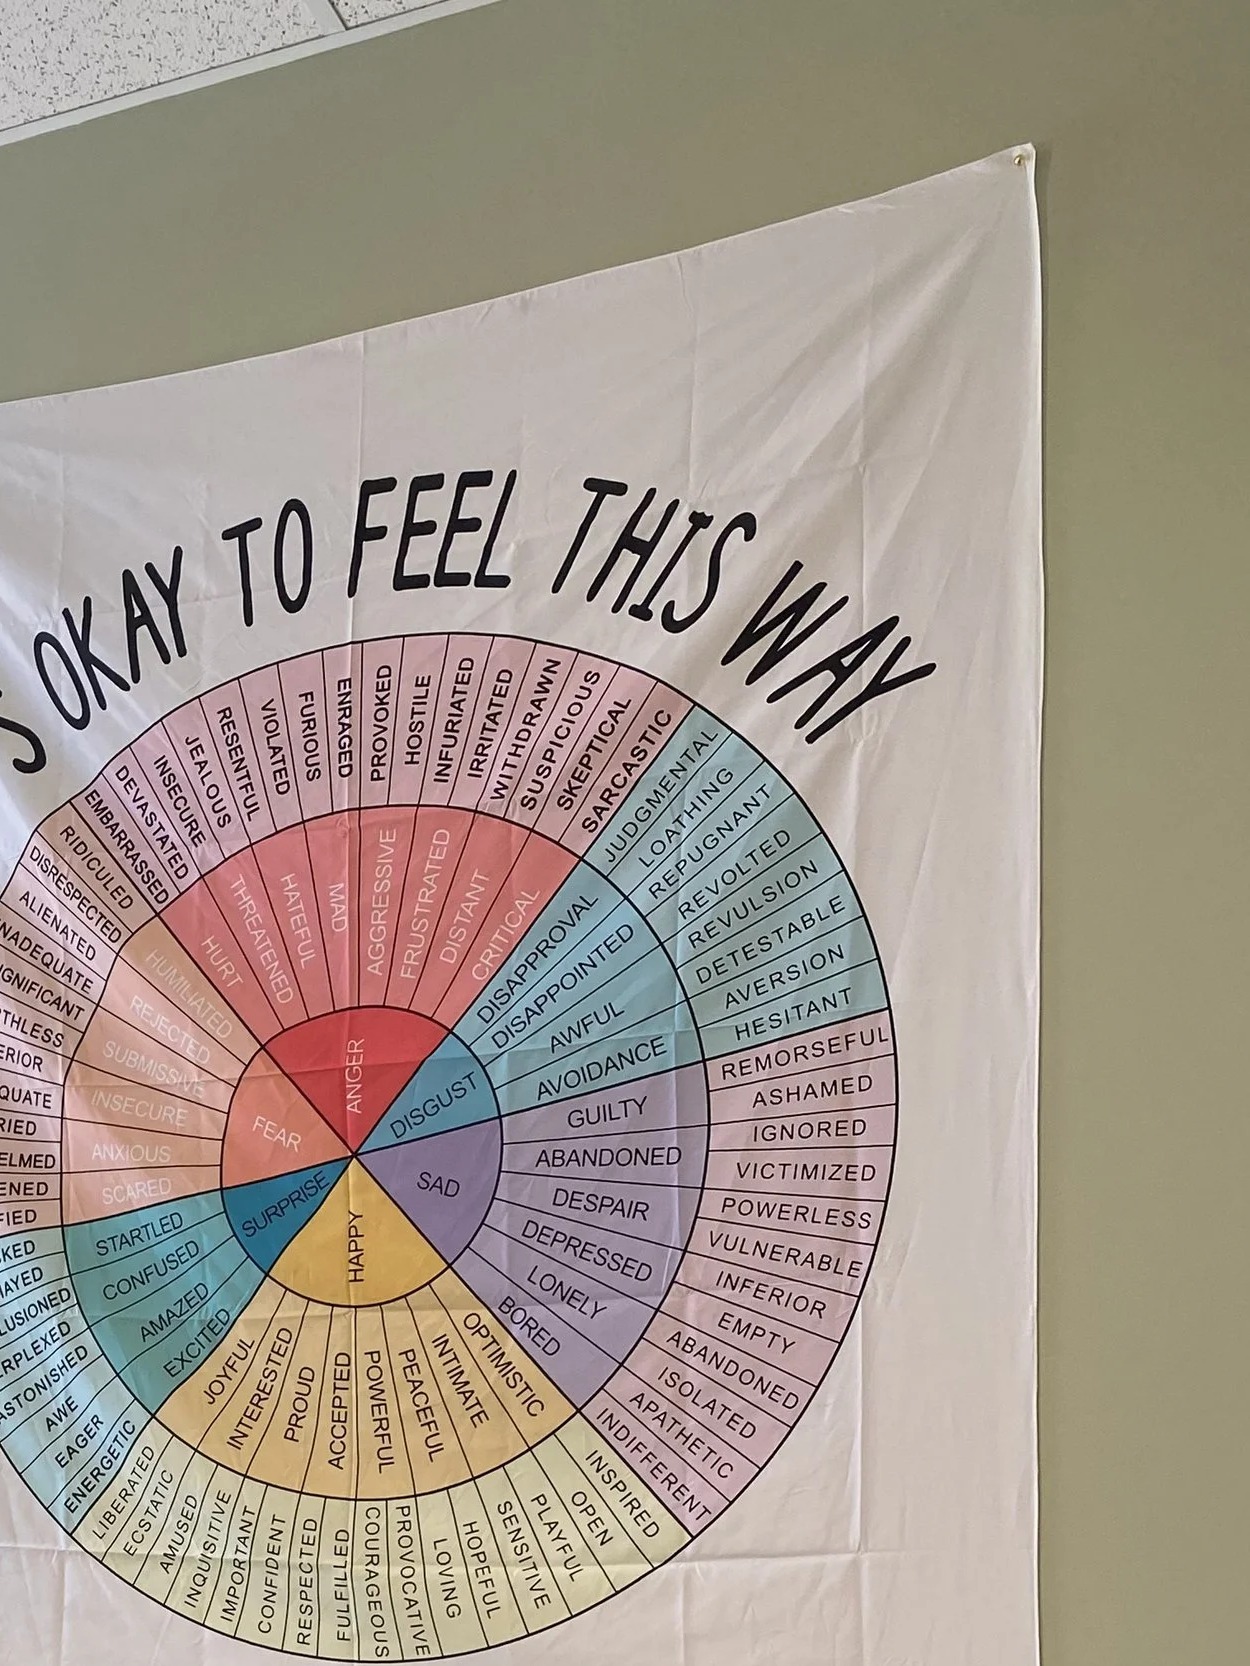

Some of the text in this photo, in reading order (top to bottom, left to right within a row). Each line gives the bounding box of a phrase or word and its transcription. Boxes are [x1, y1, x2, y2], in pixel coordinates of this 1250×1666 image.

[33, 546, 188, 730] OKAY
[221, 498, 313, 627] TO
[347, 469, 517, 598] FEEL
[551, 477, 757, 634] THIS
[721, 560, 937, 745] WAY
[260, 698, 291, 796] VIOLATED
[371, 664, 392, 782] PROVOKED
[433, 656, 476, 785] INFURIATED
[490, 657, 562, 801] WITHDRAWN
[581, 709, 672, 834] SARCASTIC
[83, 788, 170, 906] EMBARRASSED
[638, 767, 734, 868] LOATHING
[328, 883, 348, 932] MAD
[366, 828, 397, 976] AGGRESSIVE
[677, 829, 791, 920] REVOLTED
[19, 890, 97, 961] ALIENATED
[439, 869, 490, 964] DISTANT
[201, 935, 244, 988] HURT
[477, 891, 599, 1025] DISAPPROVAL
[129, 995, 211, 1065] REJECTED
[550, 1001, 625, 1053] AWFUL
[734, 987, 852, 1042] HESITANT
[344, 1038, 365, 1114] ANGER
[389, 1071, 480, 1140] DISGUST
[752, 1074, 873, 1109] ASHAMED
[251, 1115, 302, 1152] FEAR
[567, 1096, 648, 1129] GUILTY
[101, 1177, 172, 1205] SCARED
[416, 1171, 460, 1198] SAD
[535, 1146, 682, 1168] ABANDONED
[736, 1162, 877, 1182] VICTIMIZED
[96, 1211, 185, 1258] STARTLED
[241, 1170, 330, 1238] SURPRISE
[552, 1188, 650, 1221] DESPAIR
[347, 1210, 365, 1283] HAPPY
[708, 1230, 863, 1279] VULNERABLE
[163, 1308, 231, 1379] EXCITED
[497, 1296, 561, 1356] BORED
[717, 1311, 796, 1355] EMPTY
[204, 1339, 255, 1406] JOYFUL
[463, 1312, 545, 1417] OPTIMISTIC
[46, 1395, 79, 1432] AWE
[327, 1351, 351, 1470] ACCEPTED
[398, 1348, 445, 1463] PEACEFUL
[657, 1366, 757, 1439] ISOLATED
[92, 1445, 155, 1539] LIBERATED
[585, 1449, 660, 1538] INSPIRED
[257, 1513, 286, 1634] CONFIDENT
[364, 1506, 390, 1659] COURAGEOUS
[497, 1501, 552, 1610] SENSITIVE
